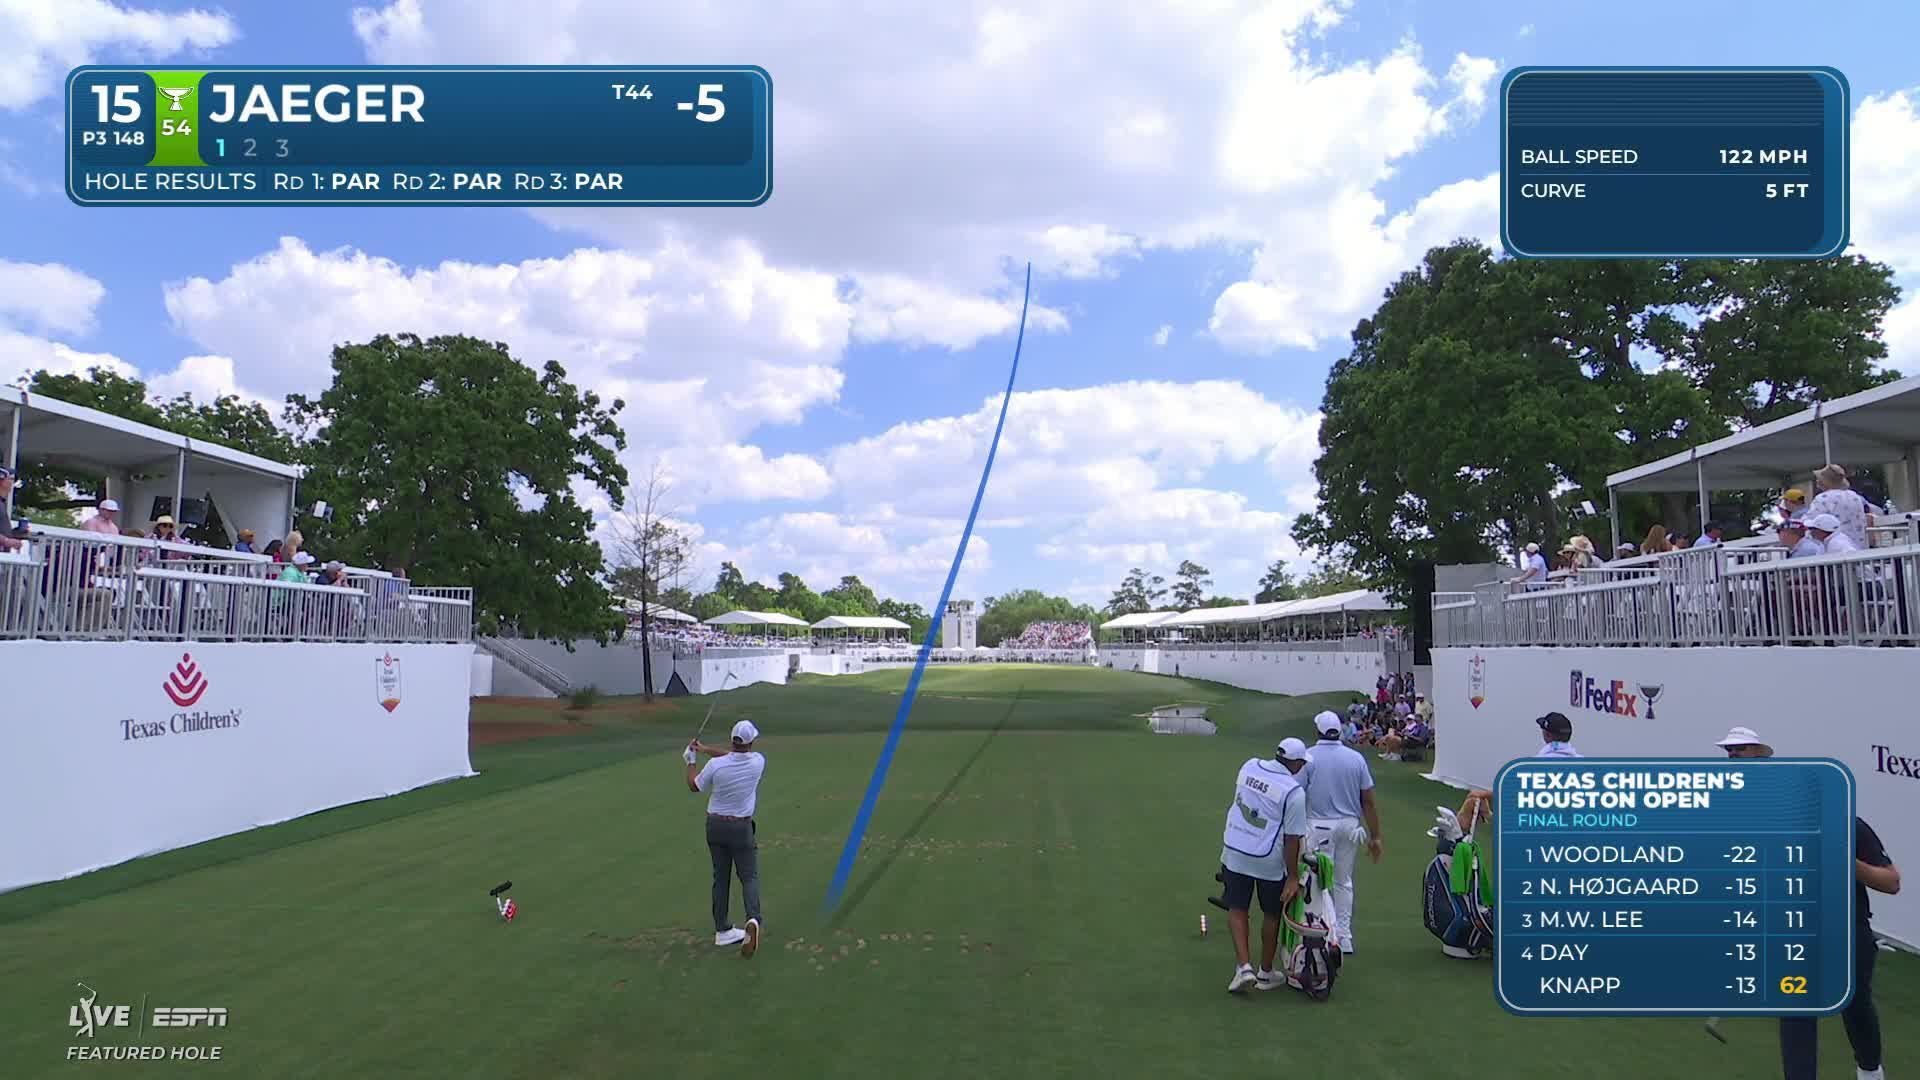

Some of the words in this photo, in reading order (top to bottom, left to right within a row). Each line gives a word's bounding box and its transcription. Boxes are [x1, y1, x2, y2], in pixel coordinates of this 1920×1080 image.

[1585, 677, 1637, 718] FedEx
[120, 719, 166, 740] Texas
[170, 709, 240, 734] Children's
[1245, 776, 1269, 794] VEGAS
